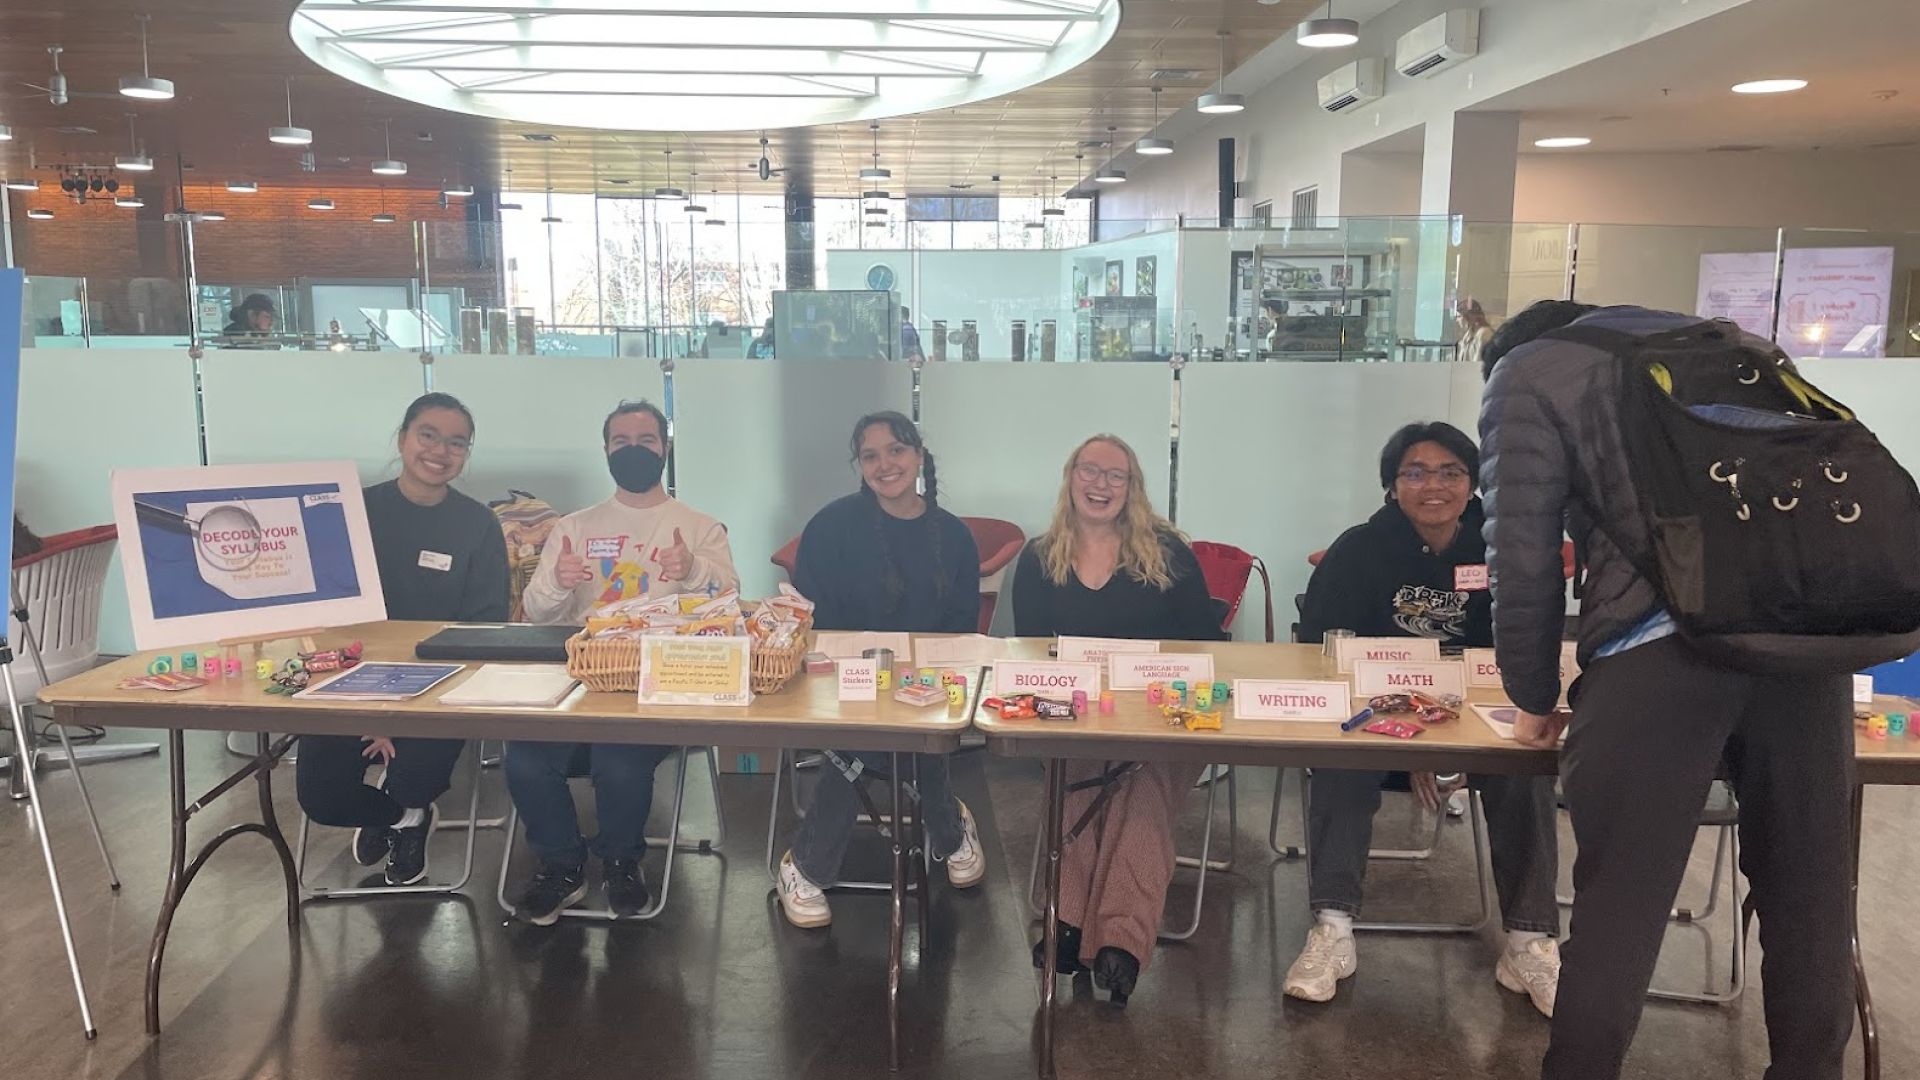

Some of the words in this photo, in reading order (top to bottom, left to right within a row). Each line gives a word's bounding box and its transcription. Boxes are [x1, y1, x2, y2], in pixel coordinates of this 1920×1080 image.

[203, 529, 260, 543] DECODE
[262, 526, 299, 538] YOUR
[221, 540, 287, 555] SYLLABUS
[1367, 651, 1411, 660] MUSIC
[842, 676, 873, 684] Stickers
[1015, 674, 1078, 687] BIOLOGY
[1387, 673, 1434, 686] MATH
[713, 693, 737, 701] CLASS
[1257, 694, 1327, 708] WRITING
